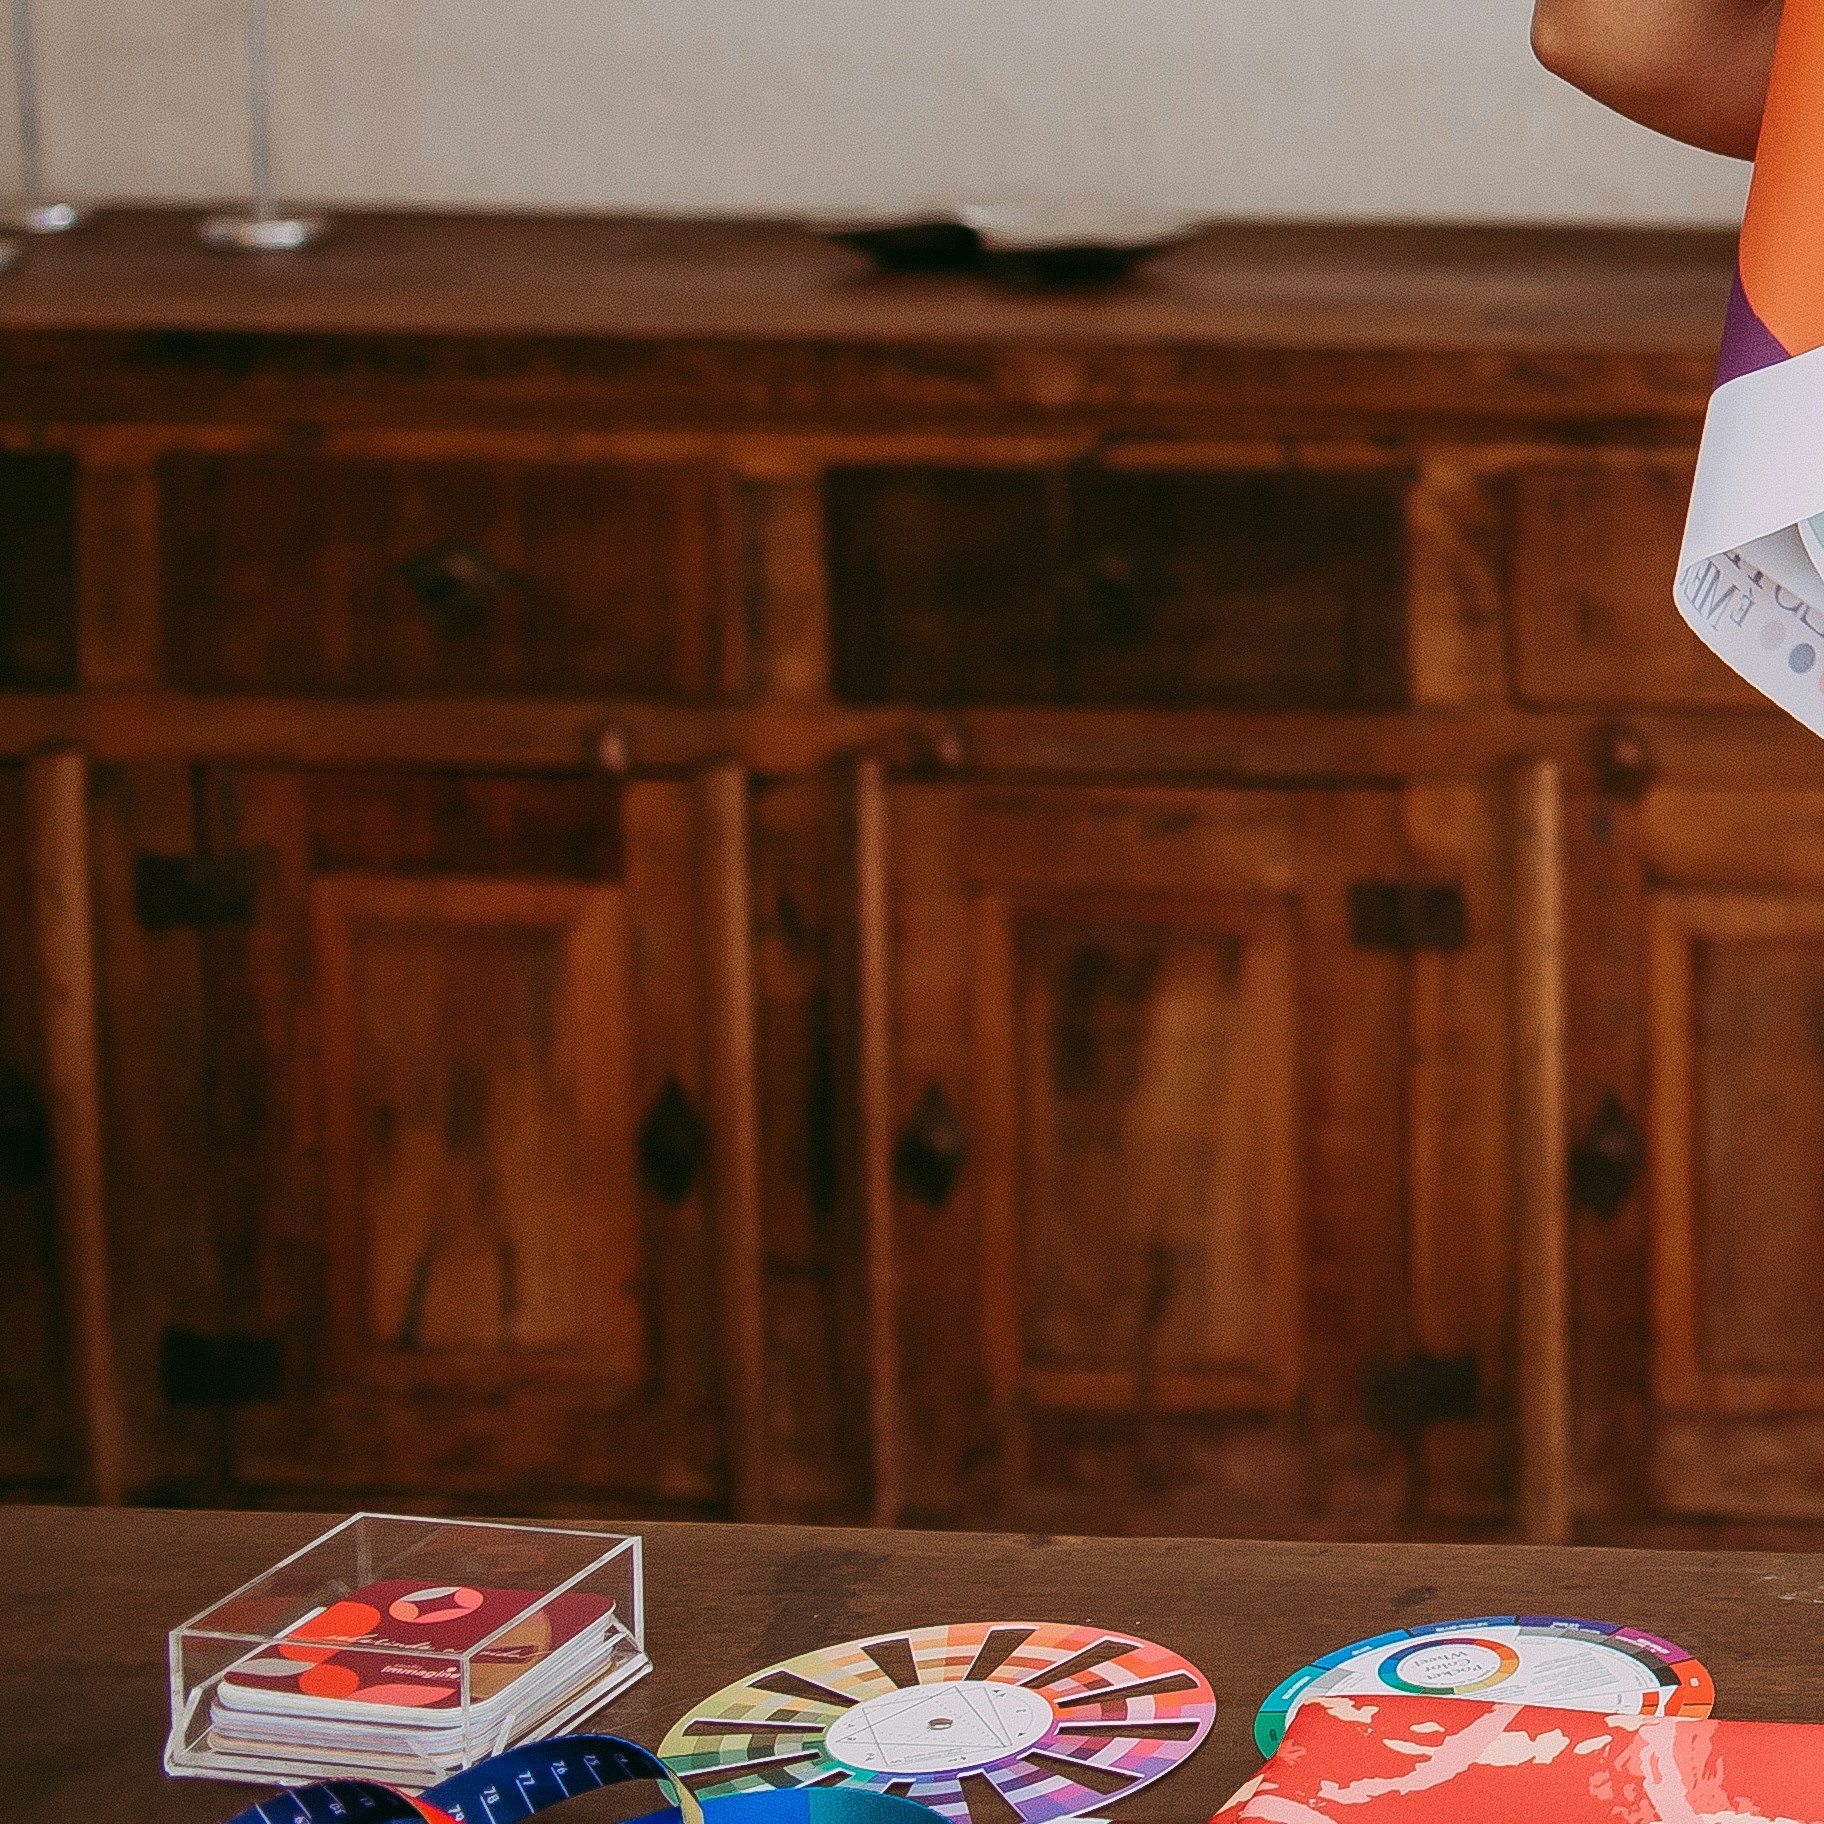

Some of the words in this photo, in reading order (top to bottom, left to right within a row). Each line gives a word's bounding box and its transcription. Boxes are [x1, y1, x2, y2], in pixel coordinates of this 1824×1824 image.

[1425, 1658, 1471, 1672] Color
[1426, 1664, 1483, 1679] Pocket
[552, 1760, 568, 1775] 76
[518, 1770, 536, 1786] 77
[483, 1785, 500, 1804] 78
[447, 1803, 465, 1822] 79
